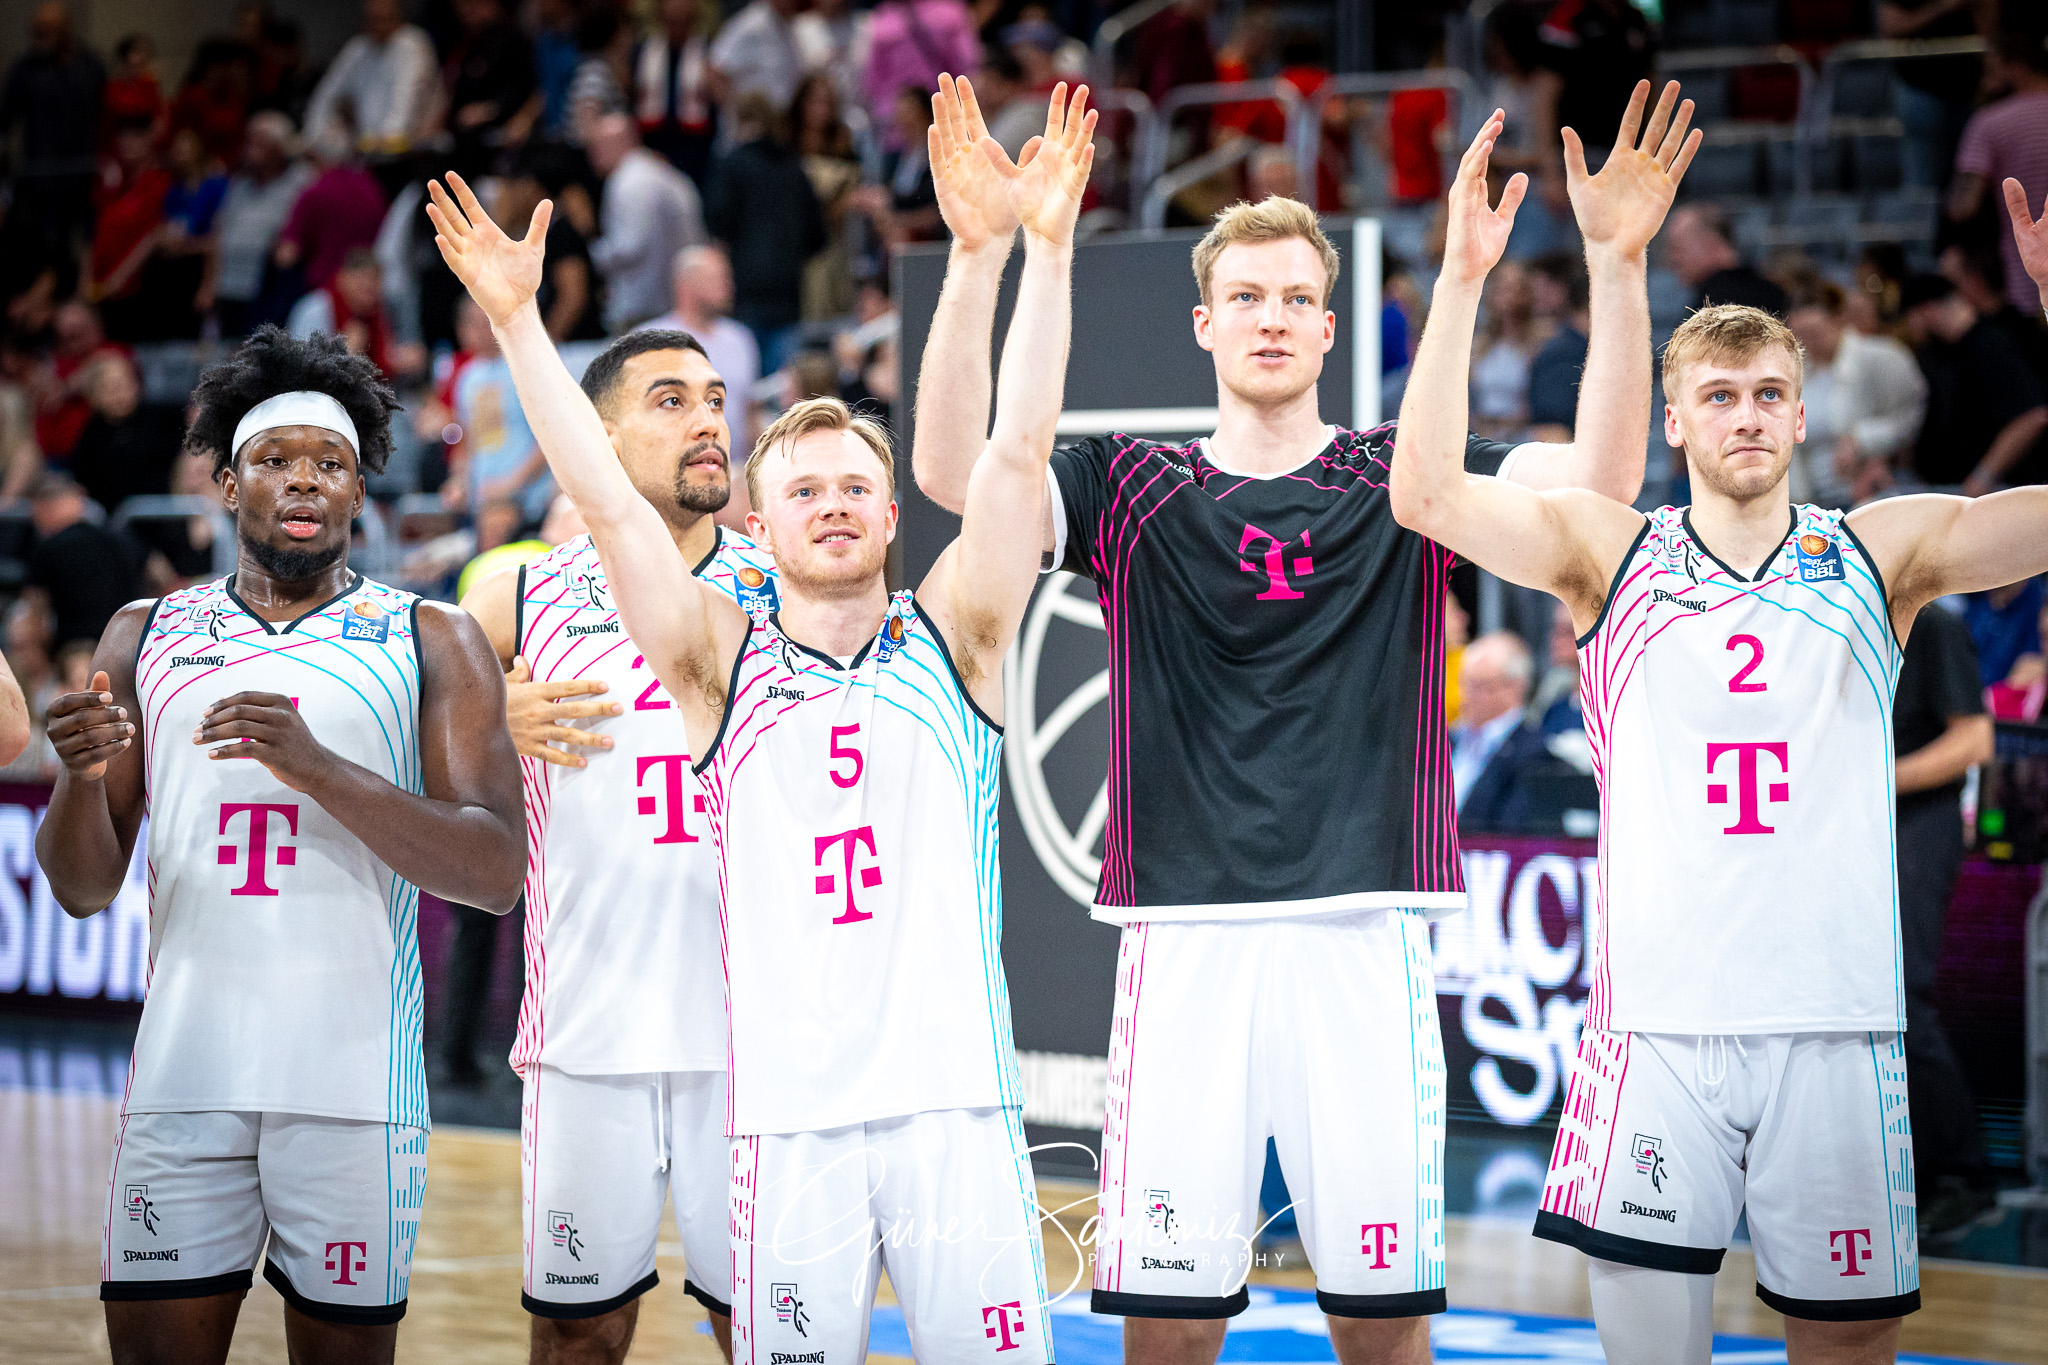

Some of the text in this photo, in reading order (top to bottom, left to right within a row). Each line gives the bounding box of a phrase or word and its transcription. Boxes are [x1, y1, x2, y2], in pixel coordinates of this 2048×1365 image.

[1804, 565, 1840, 579] BBL
[742, 600, 776, 611] BBL
[1653, 589, 1706, 613] SPALDING
[346, 626, 382, 640] BBL
[567, 621, 619, 638] SPALDING
[170, 656, 225, 668] SPALDING
[1726, 634, 1767, 692] 2
[830, 723, 863, 788] 5
[637, 755, 706, 844] T
[1707, 742, 1789, 834] T
[218, 804, 298, 896] T
[815, 826, 882, 925] T
[1620, 1201, 1677, 1223] SPALDING
[123, 1248, 178, 1262] SPALDING
[1362, 1223, 1398, 1269] T
[1830, 1229, 1872, 1277] T
[325, 1242, 366, 1285] T
[545, 1272, 599, 1285] SPALDING
[982, 1300, 1024, 1353] T
[771, 1350, 825, 1365] SPALDING
